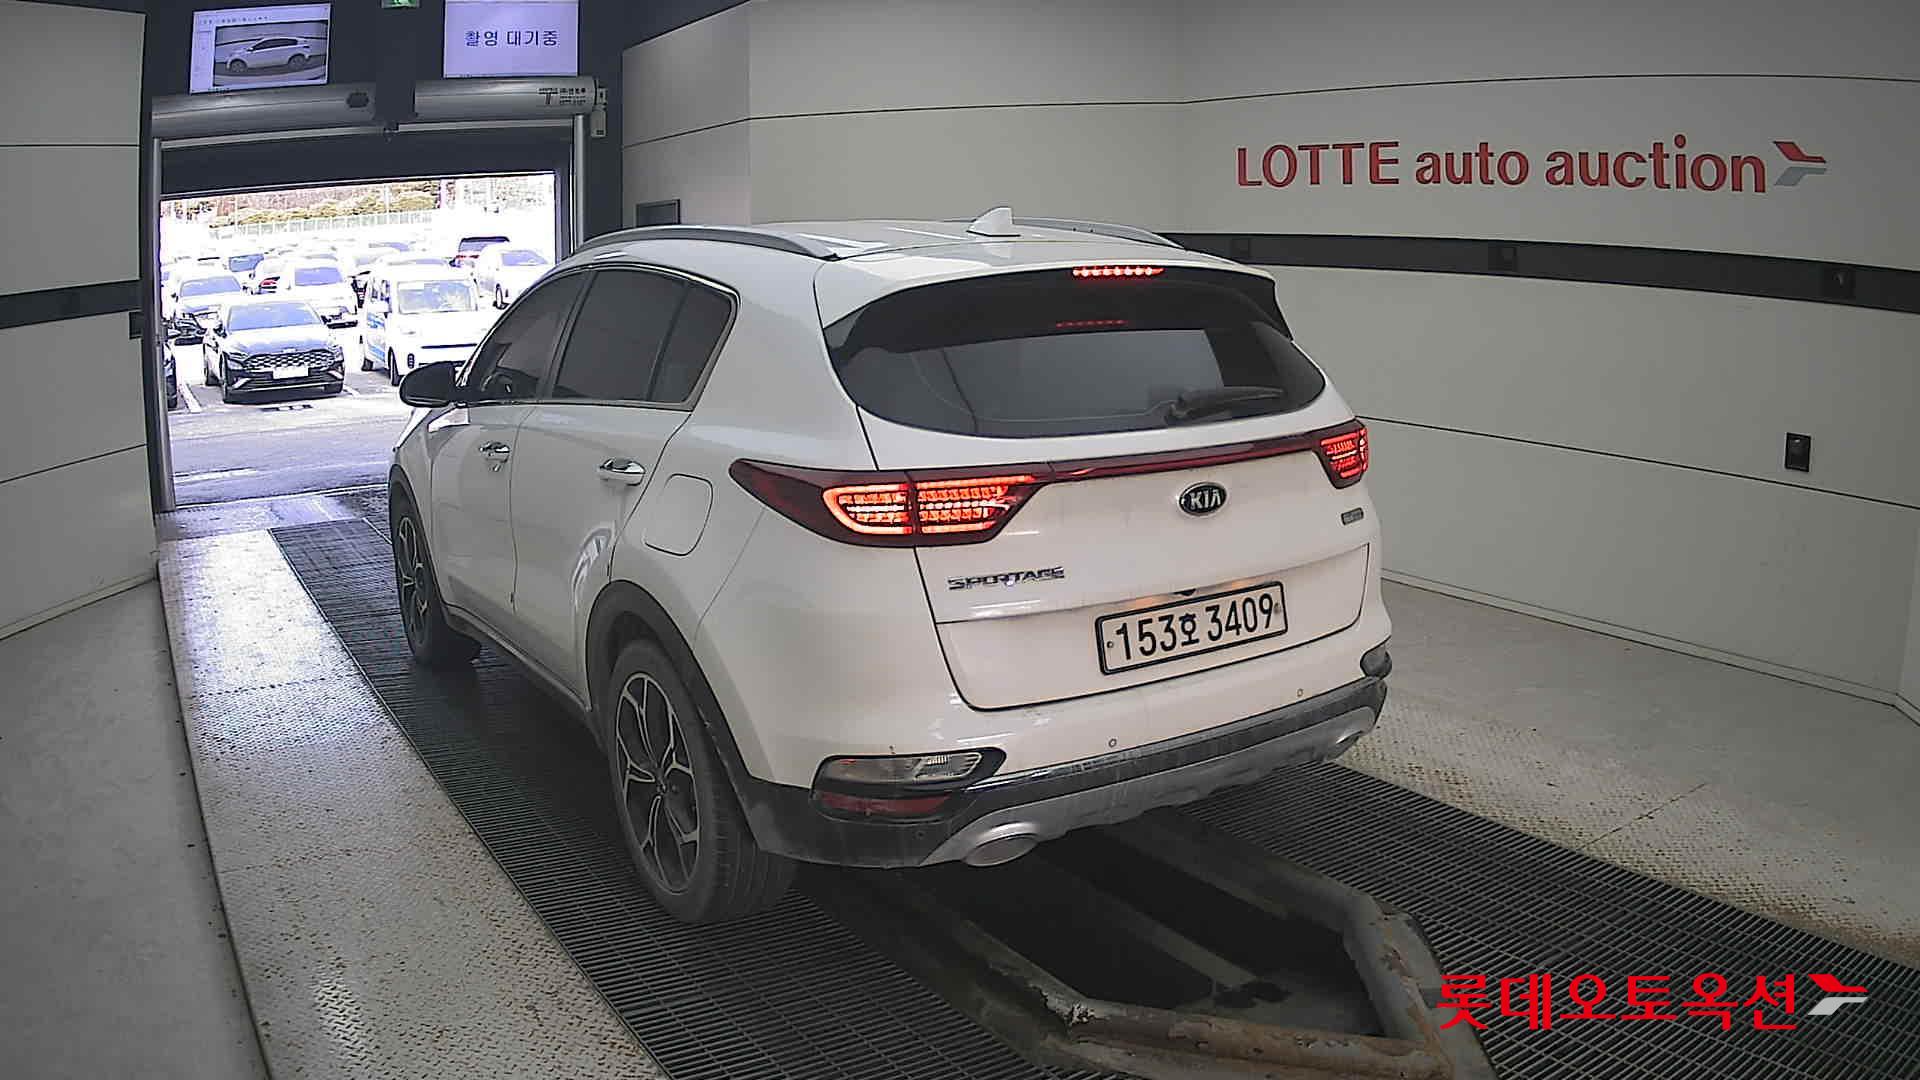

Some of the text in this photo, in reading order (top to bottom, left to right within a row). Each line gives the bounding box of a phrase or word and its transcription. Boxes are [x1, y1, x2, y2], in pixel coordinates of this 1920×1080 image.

[465, 30, 558, 47] 촬영 대기중
[1236, 134, 1765, 192] LOTTE auto auction
[1190, 489, 1221, 510] KIA
[947, 566, 1064, 590] SPORTAGE
[1116, 593, 1273, 660] 153호 3409
